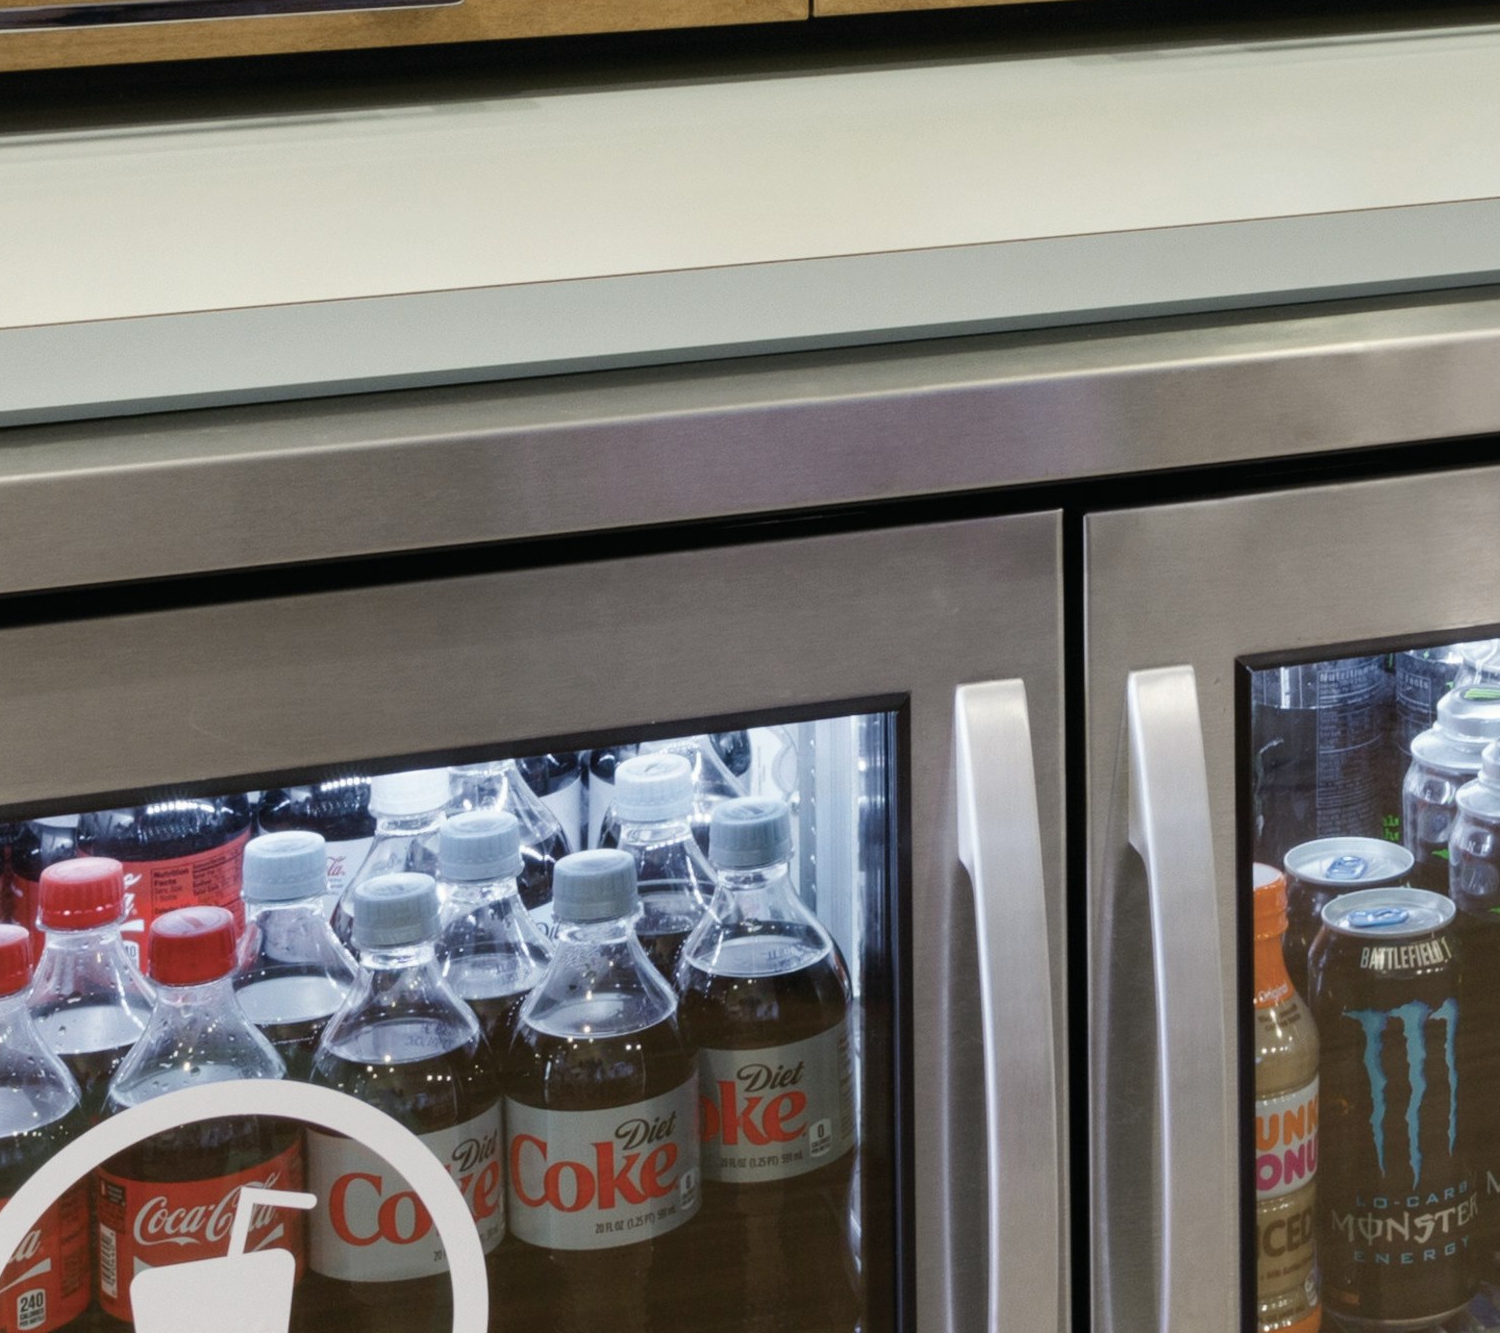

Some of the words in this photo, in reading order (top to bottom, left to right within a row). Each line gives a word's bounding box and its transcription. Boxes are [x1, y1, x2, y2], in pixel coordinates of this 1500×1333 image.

[1360, 940, 1443, 969] BATTLEFIELD
[736, 1061, 805, 1093] Diet
[615, 1111, 677, 1151] Diet
[509, 1133, 680, 1214] Coke
[1353, 1236, 1471, 1266] ENERGY
[19, 1291, 44, 1313] 240
